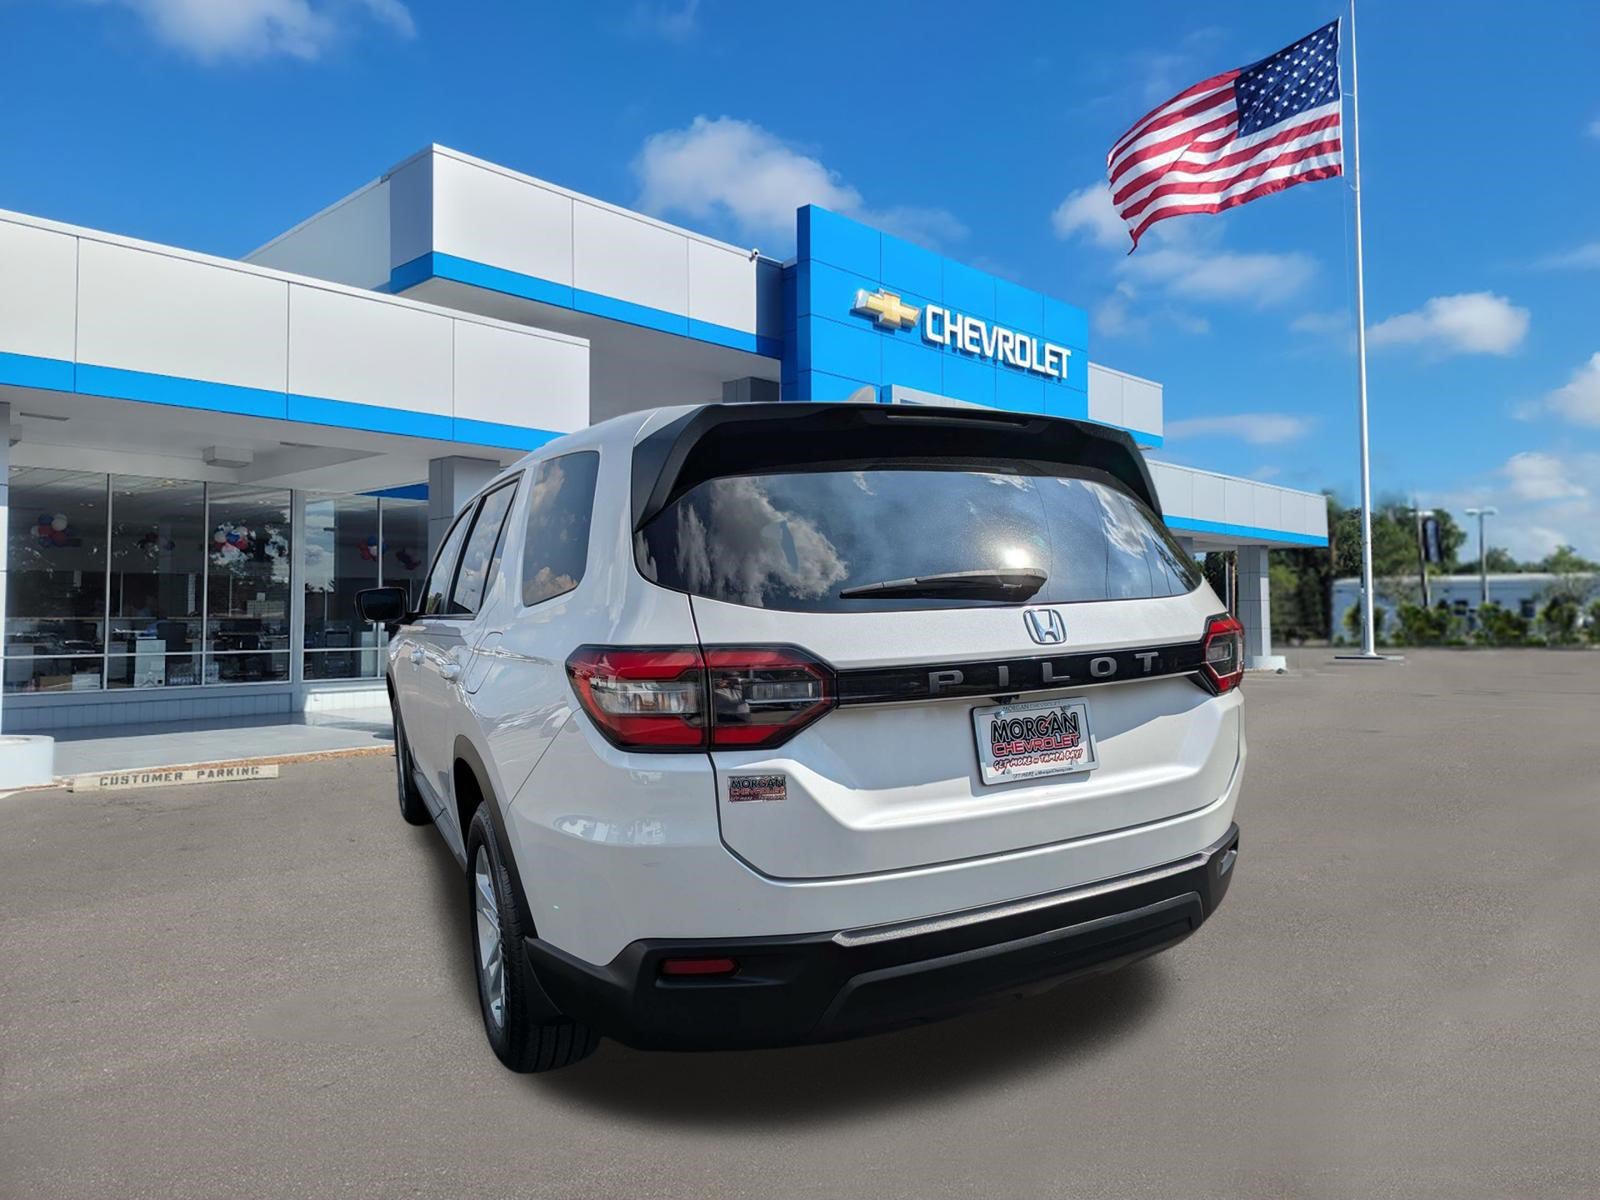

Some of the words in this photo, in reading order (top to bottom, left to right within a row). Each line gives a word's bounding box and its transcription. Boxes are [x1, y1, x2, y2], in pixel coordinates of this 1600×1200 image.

[925, 304, 1072, 379] CHEVROLET
[927, 651, 1159, 695] PILOT
[990, 711, 1080, 743] MORGAN
[991, 733, 1081, 758] CHEVROLET
[1010, 756, 1032, 767] MORE
[1039, 751, 1065, 763] TAMPA
[99, 772, 184, 787] CUSTOMER
[196, 766, 260, 780] PARKING
[731, 778, 784, 788] MORGAN
